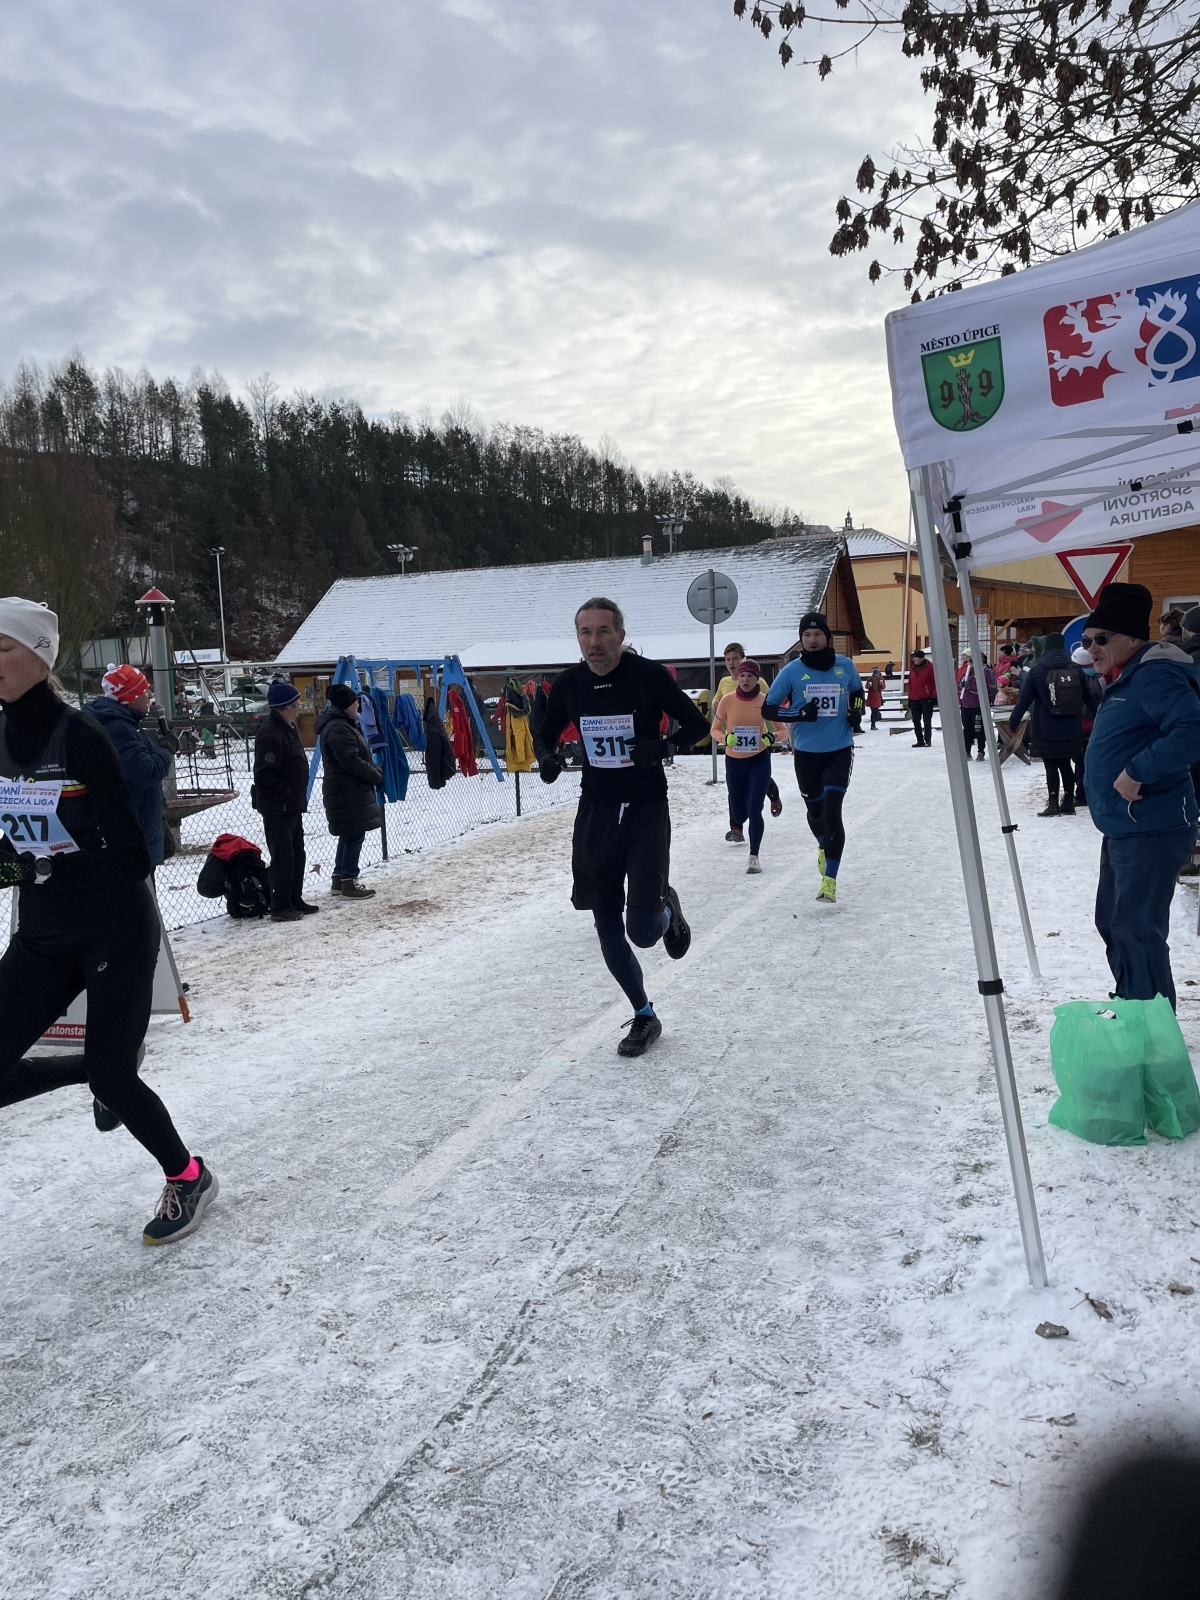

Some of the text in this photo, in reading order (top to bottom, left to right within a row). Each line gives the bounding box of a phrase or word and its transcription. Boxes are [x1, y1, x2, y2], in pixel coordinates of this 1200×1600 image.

[920, 324, 1001, 353] MĚSTO ÚPICE
[811, 696, 836, 709] 281
[582, 718, 603, 726] ZIMNÍ
[592, 735, 627, 757] 311
[735, 736, 757, 747] 314
[33, 798, 55, 806] LIGA
[1, 813, 48, 842] 217
